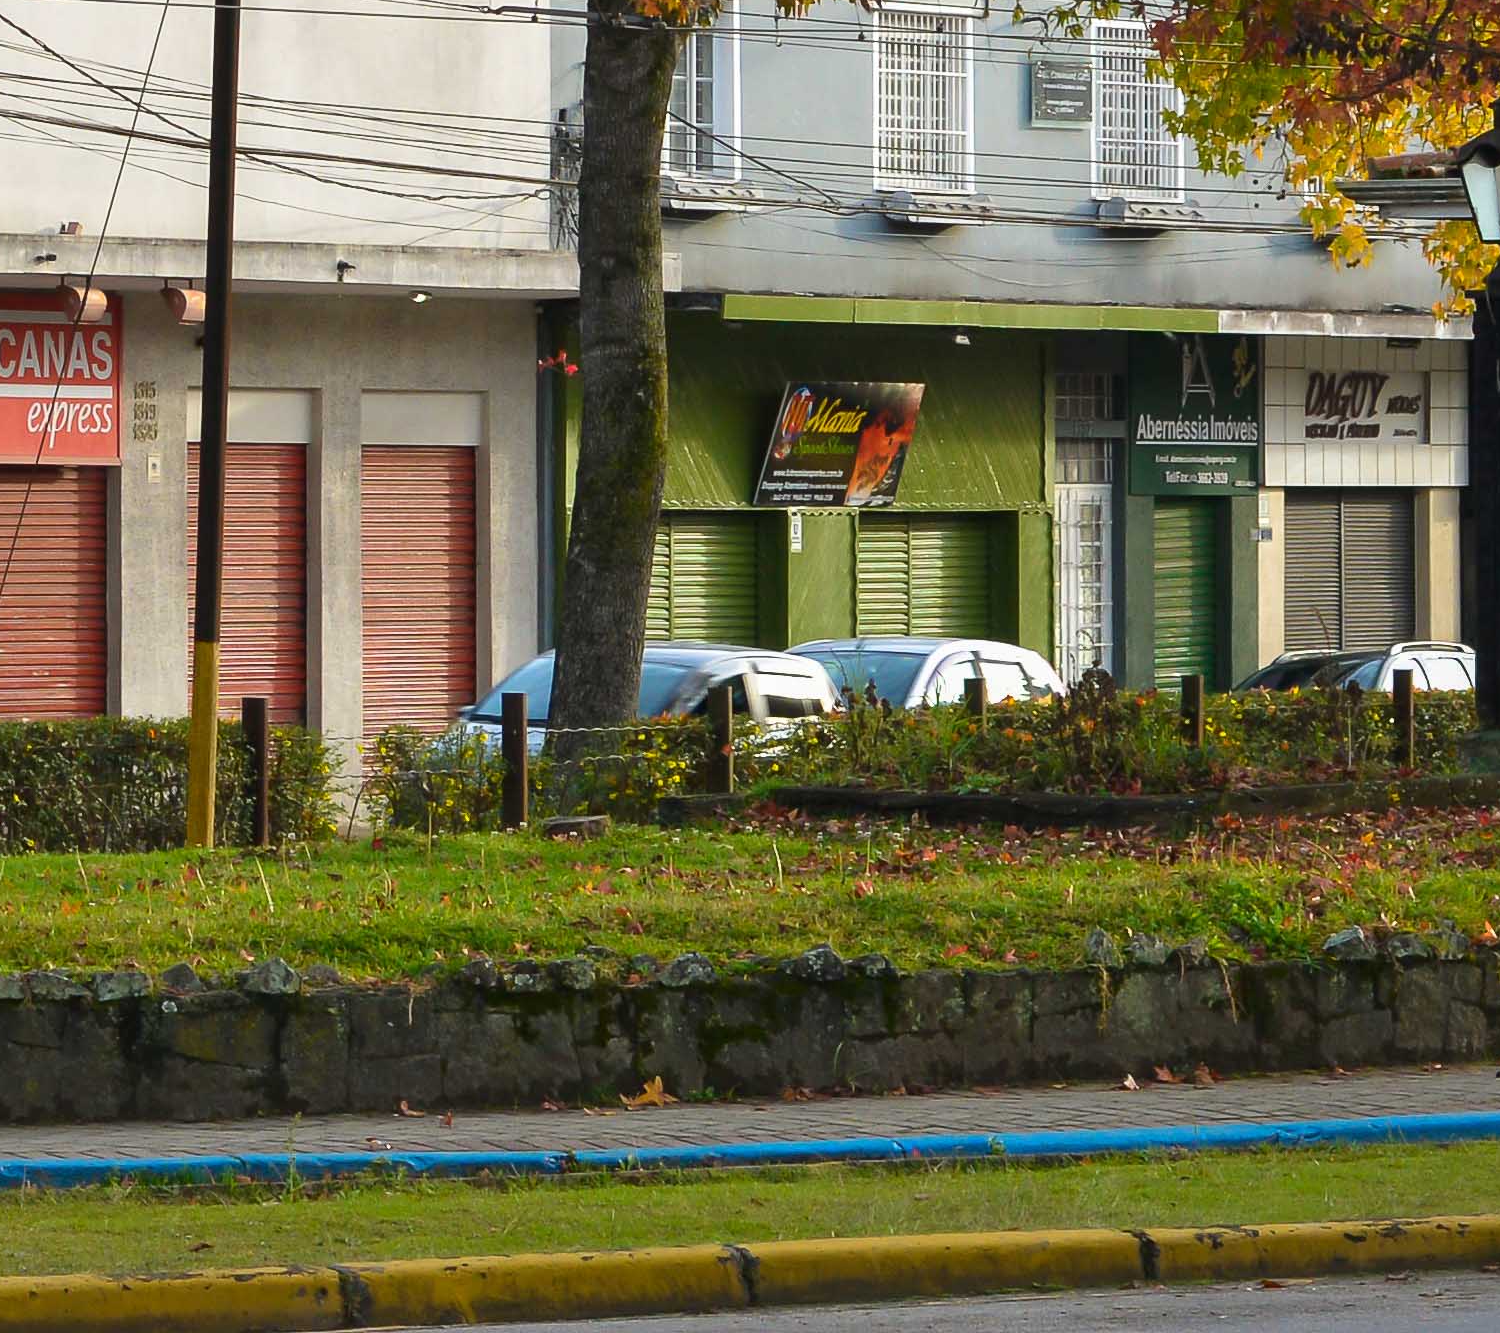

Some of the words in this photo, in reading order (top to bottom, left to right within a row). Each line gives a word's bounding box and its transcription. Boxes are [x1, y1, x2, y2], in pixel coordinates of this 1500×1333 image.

[27, 401, 113, 449] express
[1136, 413, 1209, 440] Abernéssia
[1210, 414, 1258, 441] Imóveis
